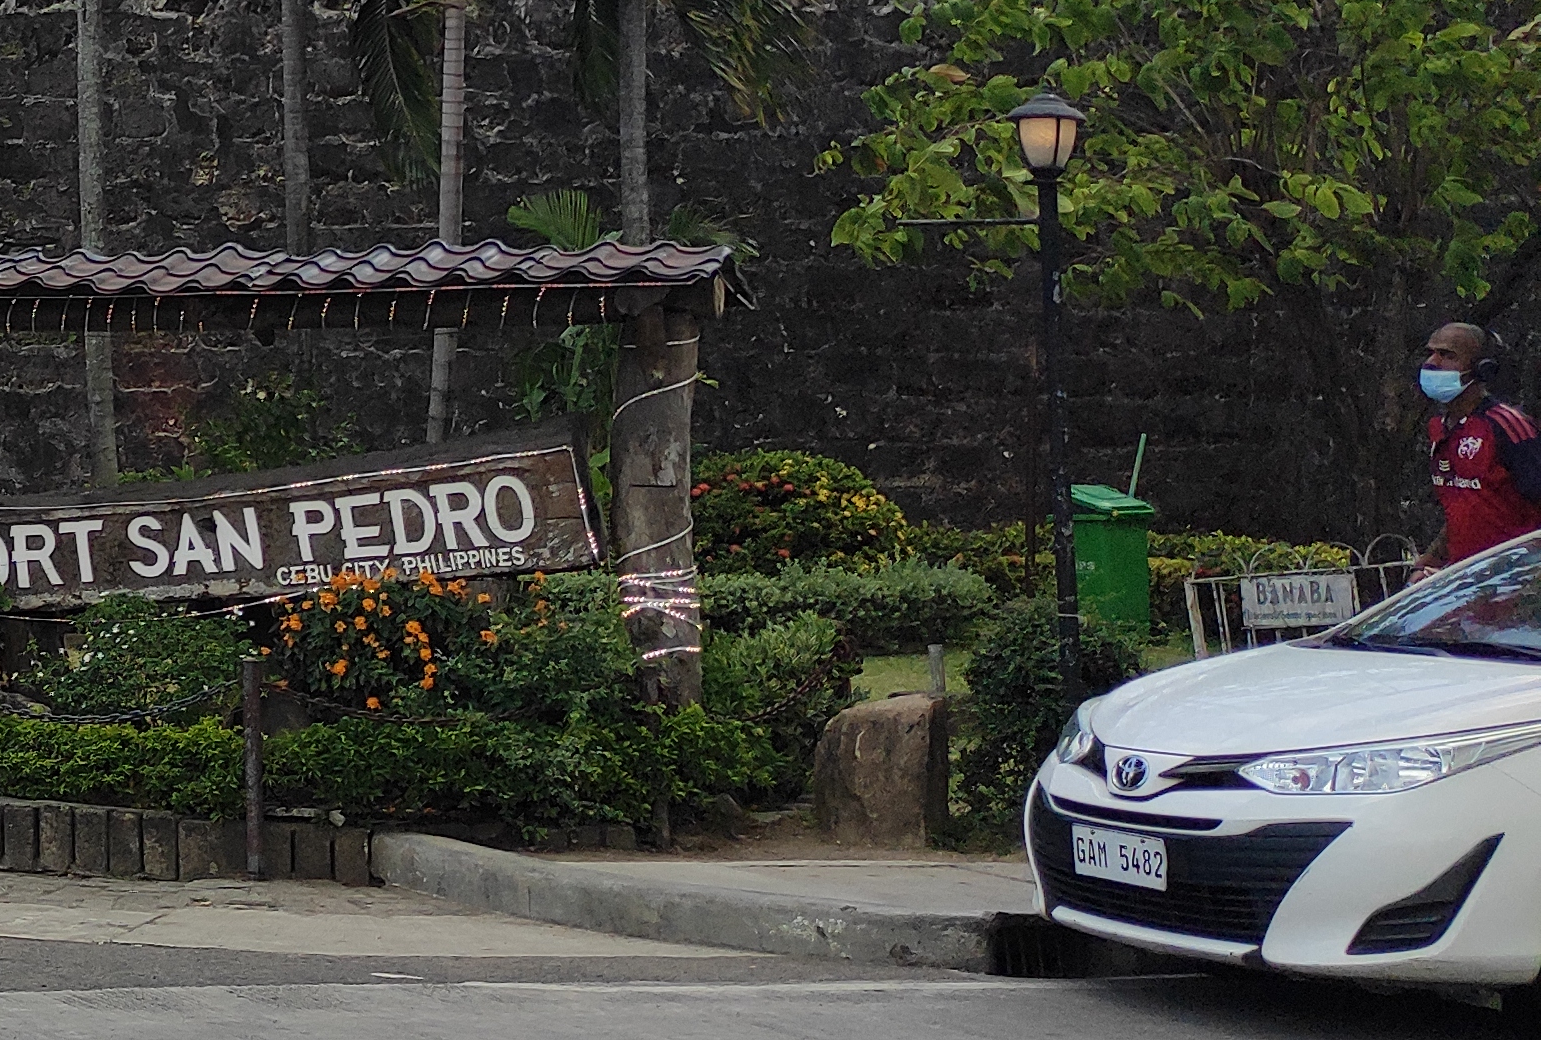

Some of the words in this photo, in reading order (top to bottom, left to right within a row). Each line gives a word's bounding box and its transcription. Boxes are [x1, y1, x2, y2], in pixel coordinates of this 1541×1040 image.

[127, 507, 264, 578] SAN
[289, 475, 535, 562] PEDRO
[276, 564, 332, 586] CEBU
[341, 559, 390, 578] CITY
[401, 546, 525, 576] PHILIPPINES
[1255, 580, 1334, 605] BANABA
[1076, 837, 1108, 868] GAM
[1119, 845, 1163, 879] 5482
